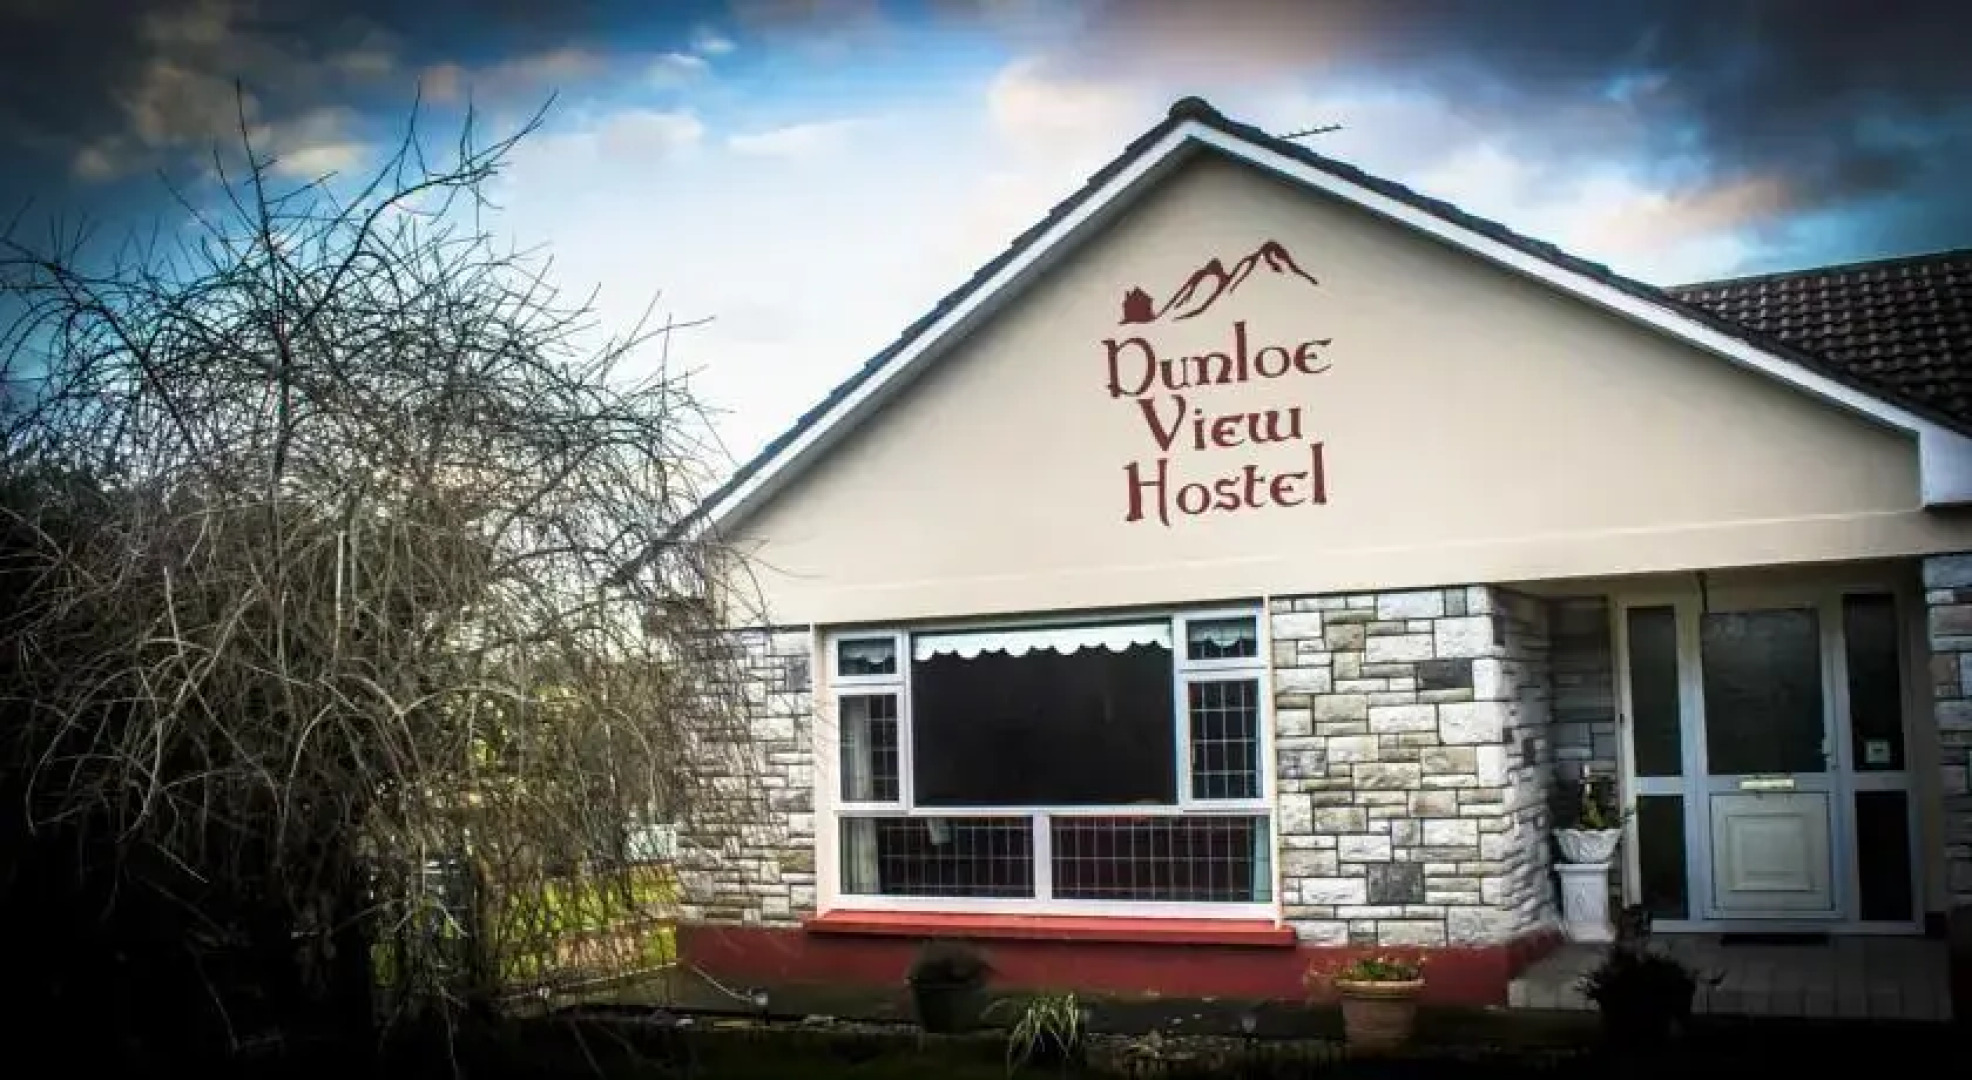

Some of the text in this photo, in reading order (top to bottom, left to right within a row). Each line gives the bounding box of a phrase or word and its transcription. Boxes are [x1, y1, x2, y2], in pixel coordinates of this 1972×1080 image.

[1101, 321, 1332, 398] Dunloe
[1138, 394, 1303, 451] View
[1123, 442, 1327, 526] Hostel
